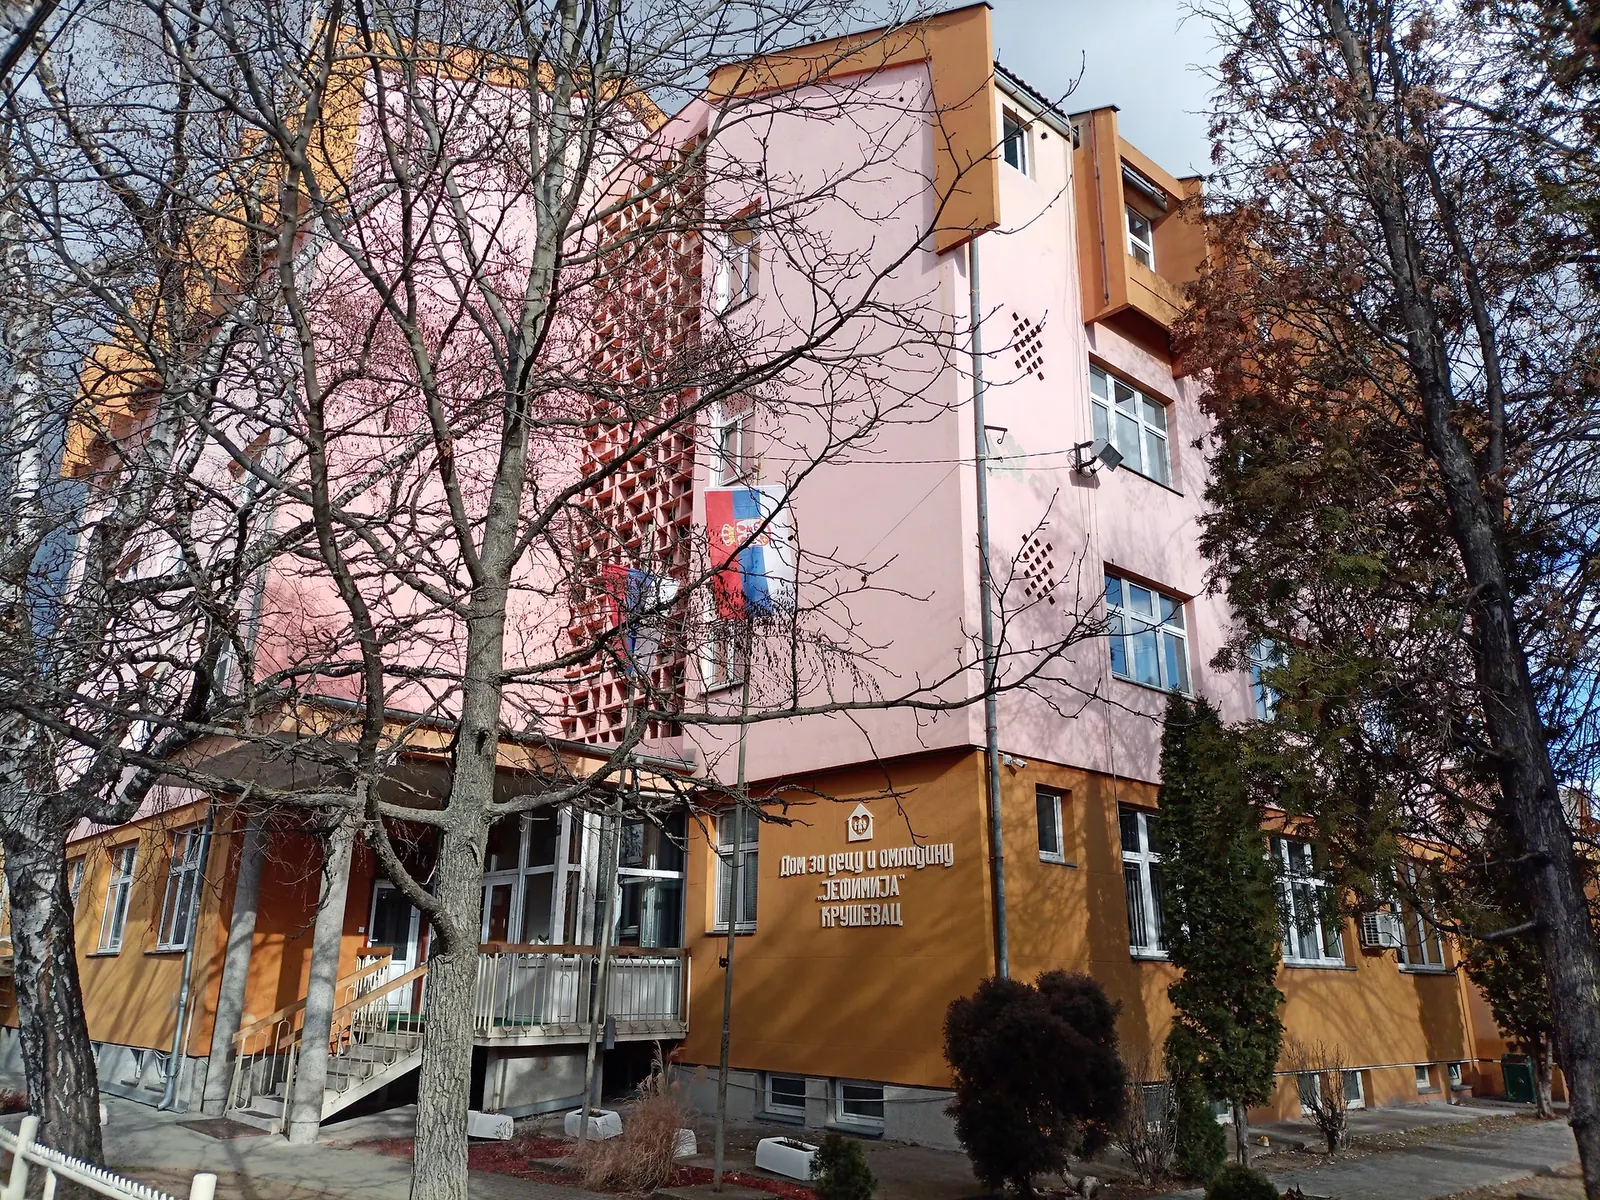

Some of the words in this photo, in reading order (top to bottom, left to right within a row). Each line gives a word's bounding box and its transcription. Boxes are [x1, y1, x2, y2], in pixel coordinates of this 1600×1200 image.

[780, 855, 806, 877] Дом
[809, 854, 825, 873] за
[828, 851, 864, 876] децу
[867, 850, 876, 869] и
[879, 843, 954, 870] омладину
[821, 902, 904, 928] КРУШЕВАЦ
